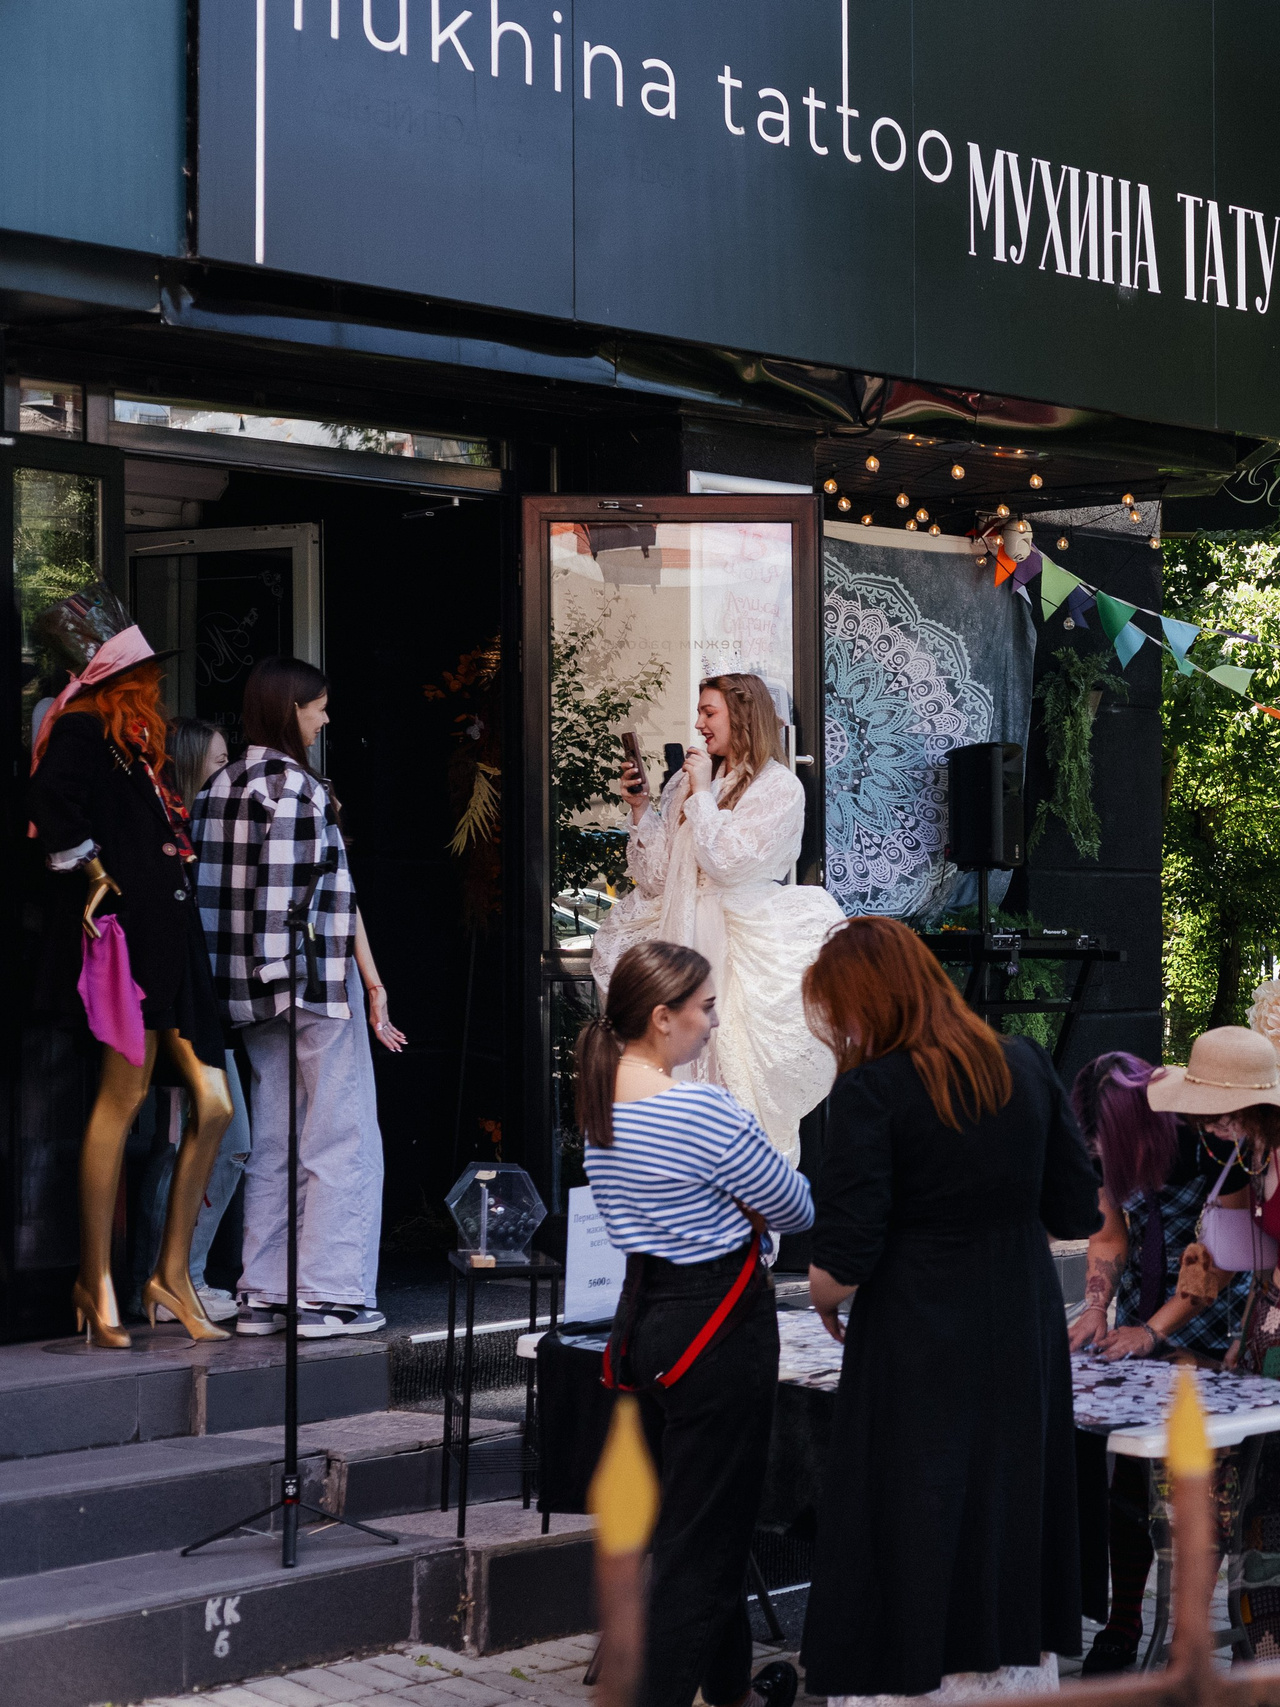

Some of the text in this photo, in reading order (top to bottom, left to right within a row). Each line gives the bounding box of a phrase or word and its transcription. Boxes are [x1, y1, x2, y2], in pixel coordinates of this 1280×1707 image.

[717, 0, 953, 184] tattoo
[966, 141, 1280, 314] МУХИНА ТАТУ
[574, 1213, 601, 1224] Перман
